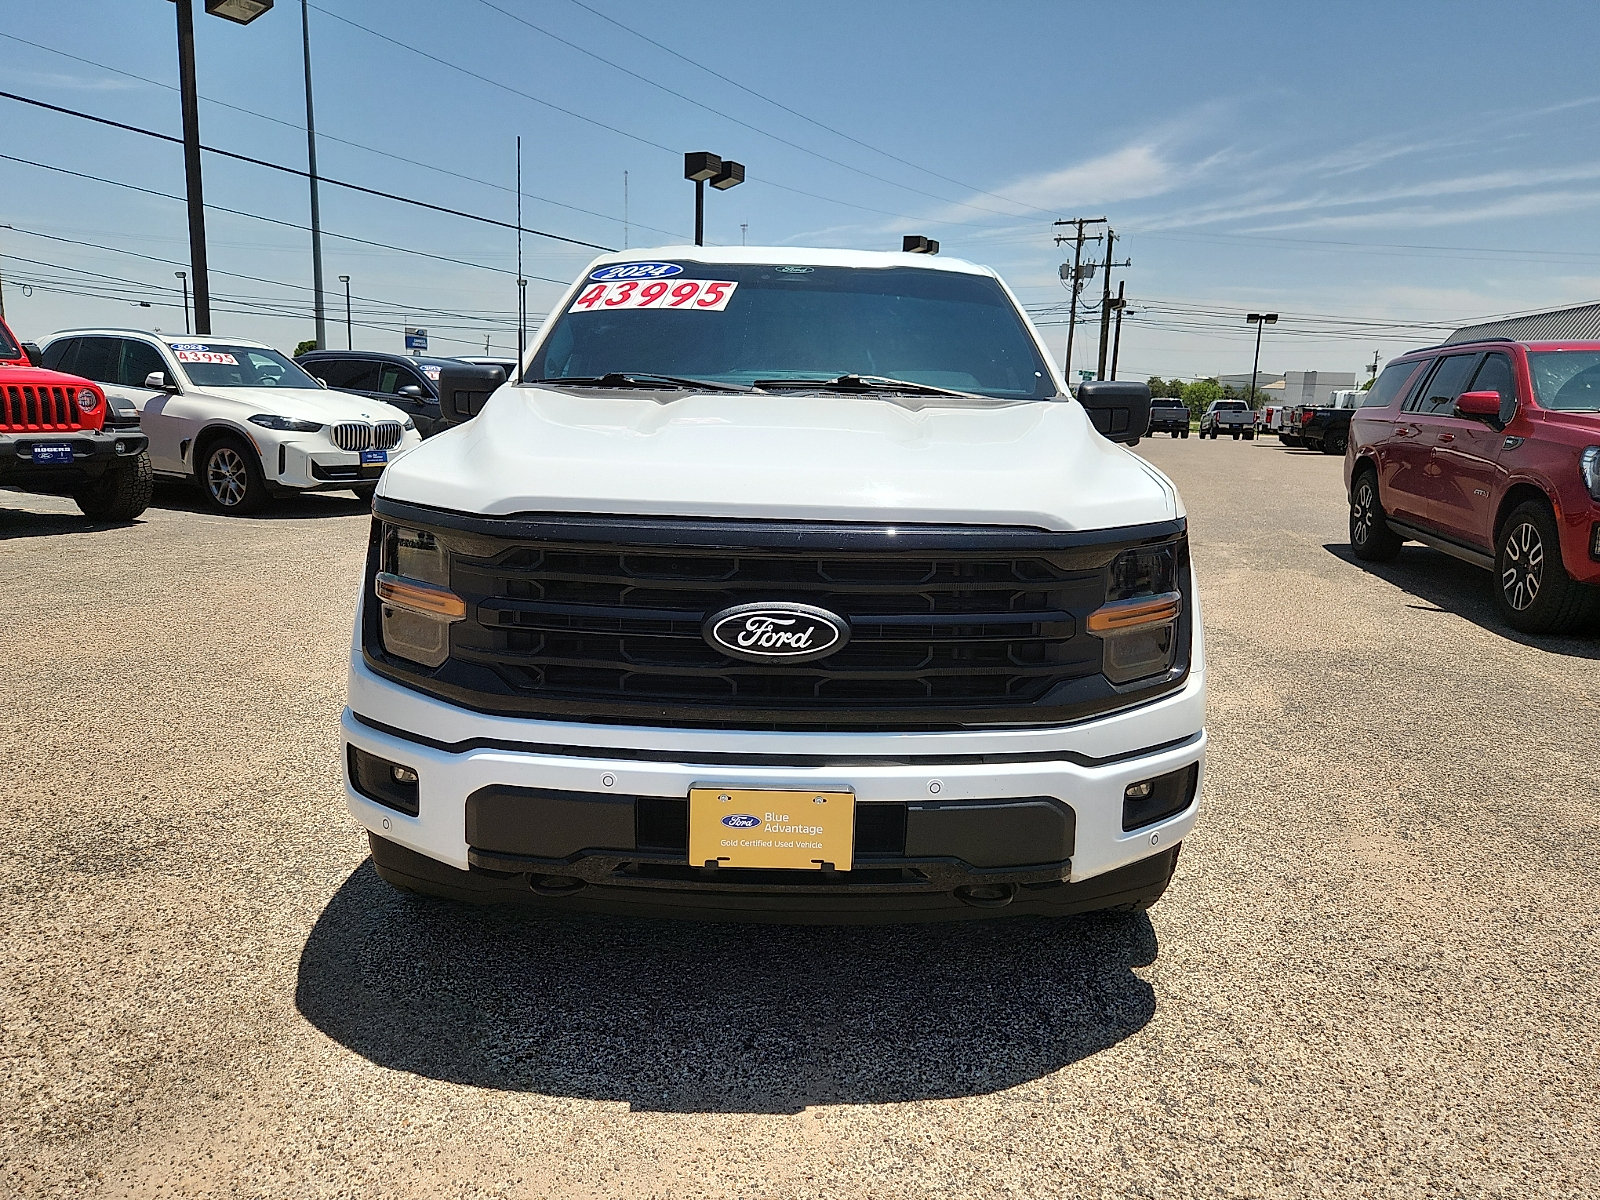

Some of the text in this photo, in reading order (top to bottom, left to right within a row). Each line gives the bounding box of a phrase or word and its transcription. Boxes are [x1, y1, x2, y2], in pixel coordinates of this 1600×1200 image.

[606, 263, 669, 279] 2024
[579, 281, 732, 308] 43995
[179, 352, 235, 363] 43995
[737, 616, 815, 648] Ford
[728, 816, 754, 827] Ford
[764, 812, 790, 822] Blue
[764, 824, 824, 836] Advantage
[720, 839, 823, 849] Gold Certified Used Vehicle
